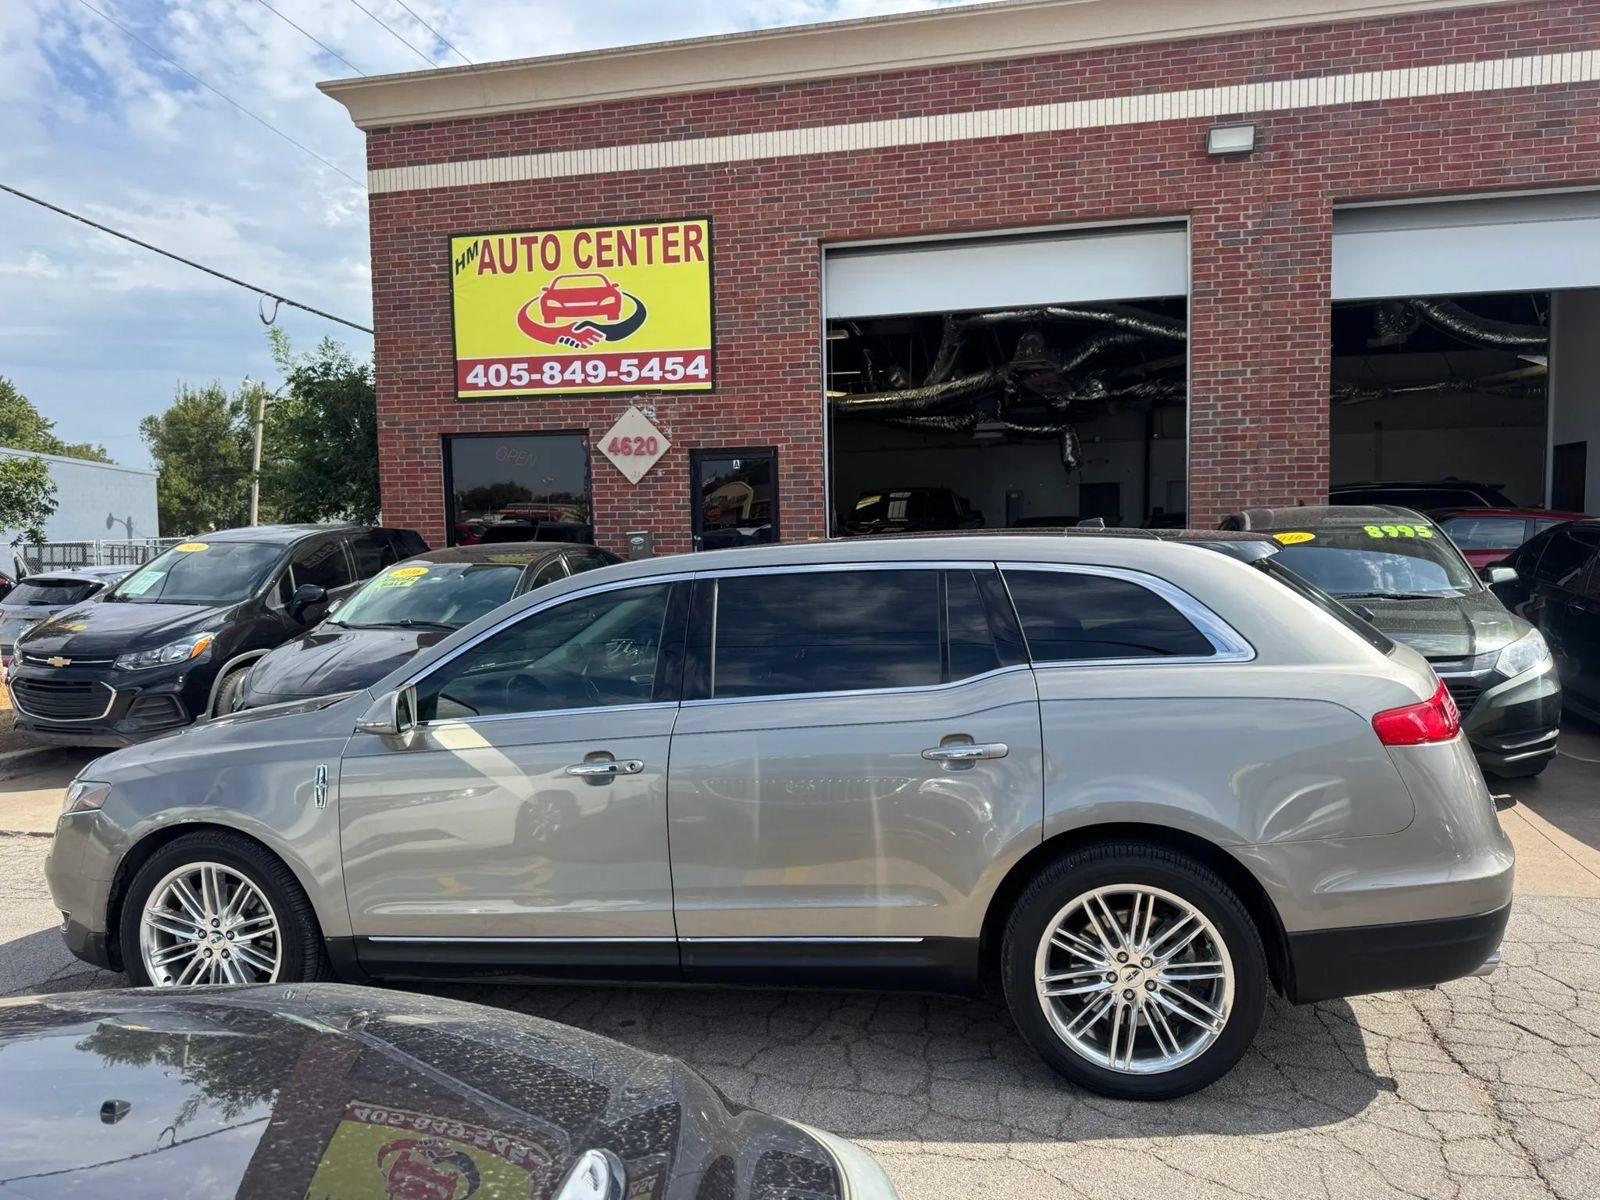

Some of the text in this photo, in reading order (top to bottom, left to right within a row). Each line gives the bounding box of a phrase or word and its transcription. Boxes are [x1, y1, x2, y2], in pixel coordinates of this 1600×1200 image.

[455, 224, 705, 276] HM AUTO CENTER
[465, 355, 709, 388] 405-849-5454
[496, 446, 537, 467] OPEN
[607, 436, 658, 456] 4620
[1364, 525, 1433, 538] 8995
